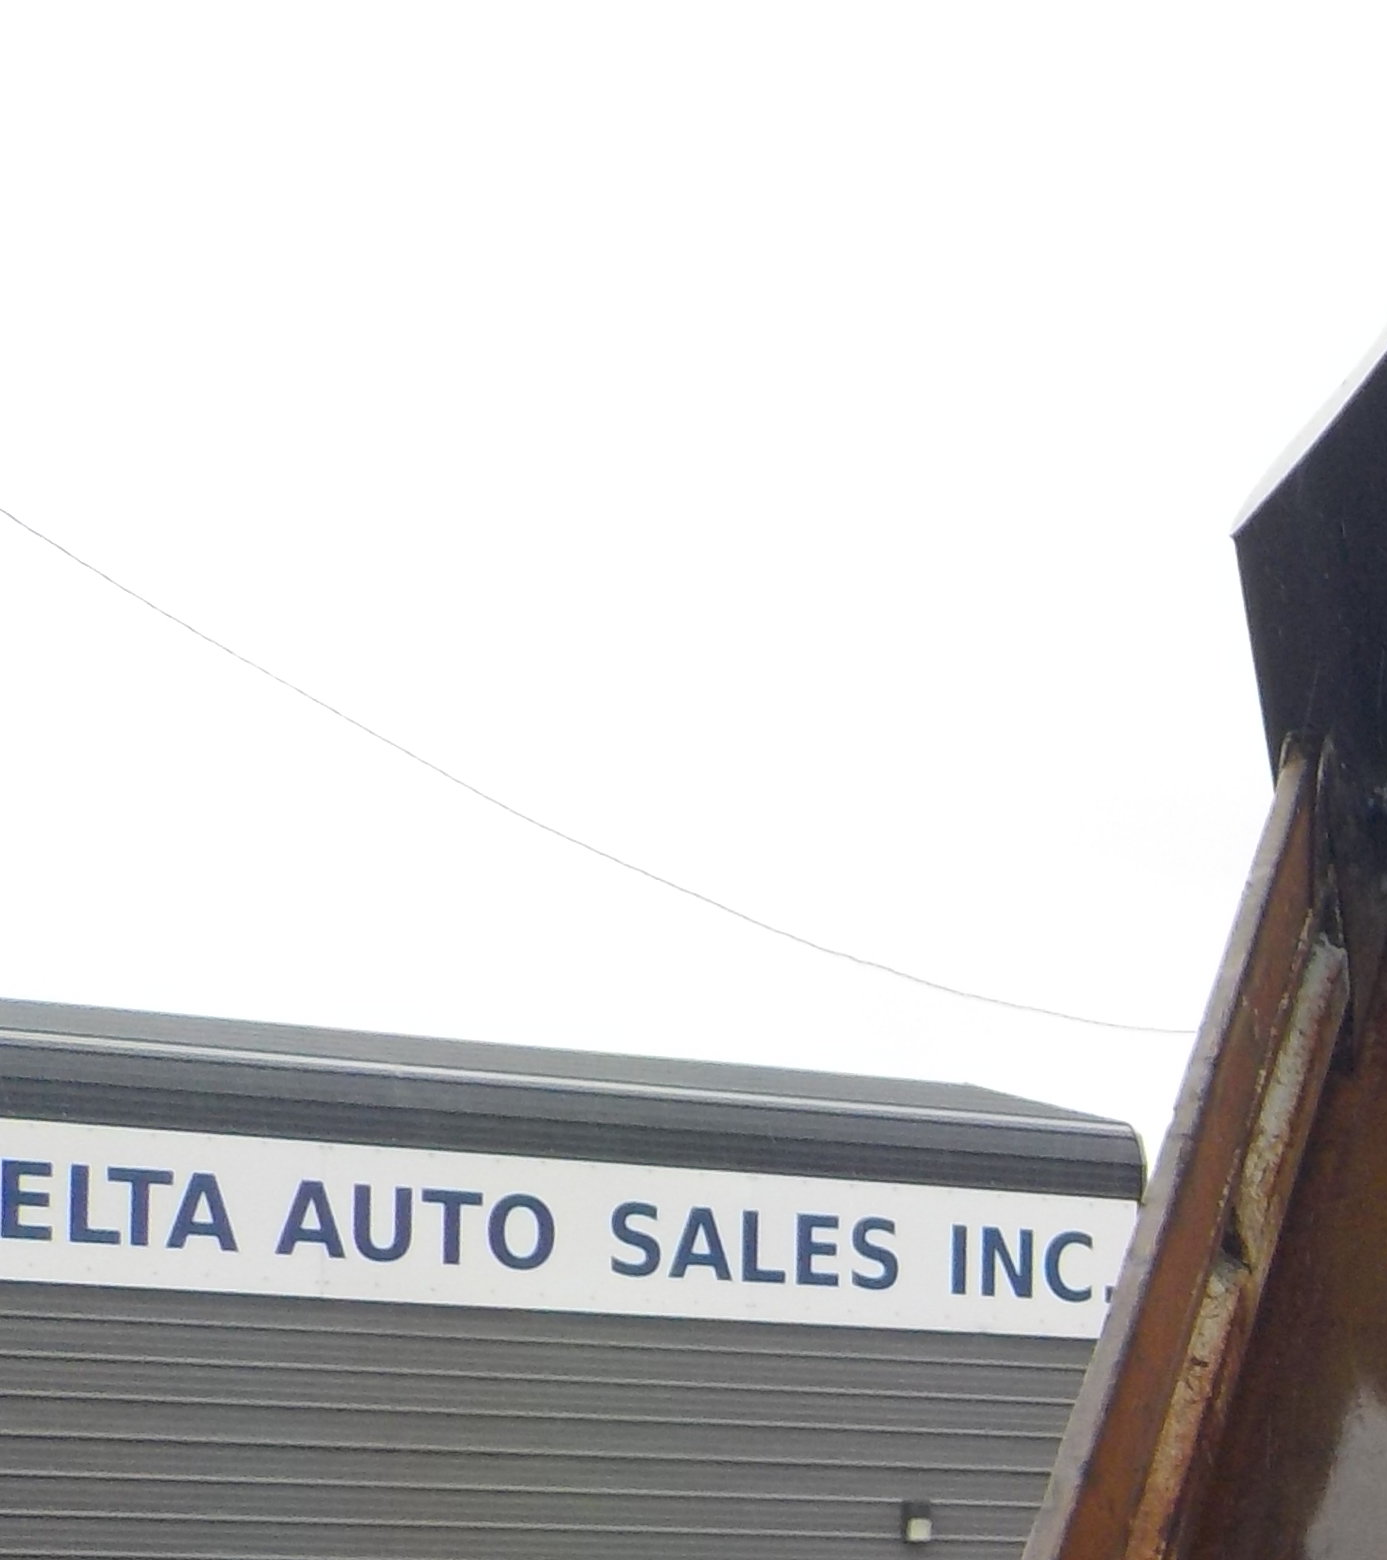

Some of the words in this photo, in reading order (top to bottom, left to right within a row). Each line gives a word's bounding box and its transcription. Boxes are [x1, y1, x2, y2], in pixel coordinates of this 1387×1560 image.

[276, 1178, 556, 1272] AUTO
[609, 1201, 900, 1291] SALES
[951, 1224, 1114, 1303] INC.
